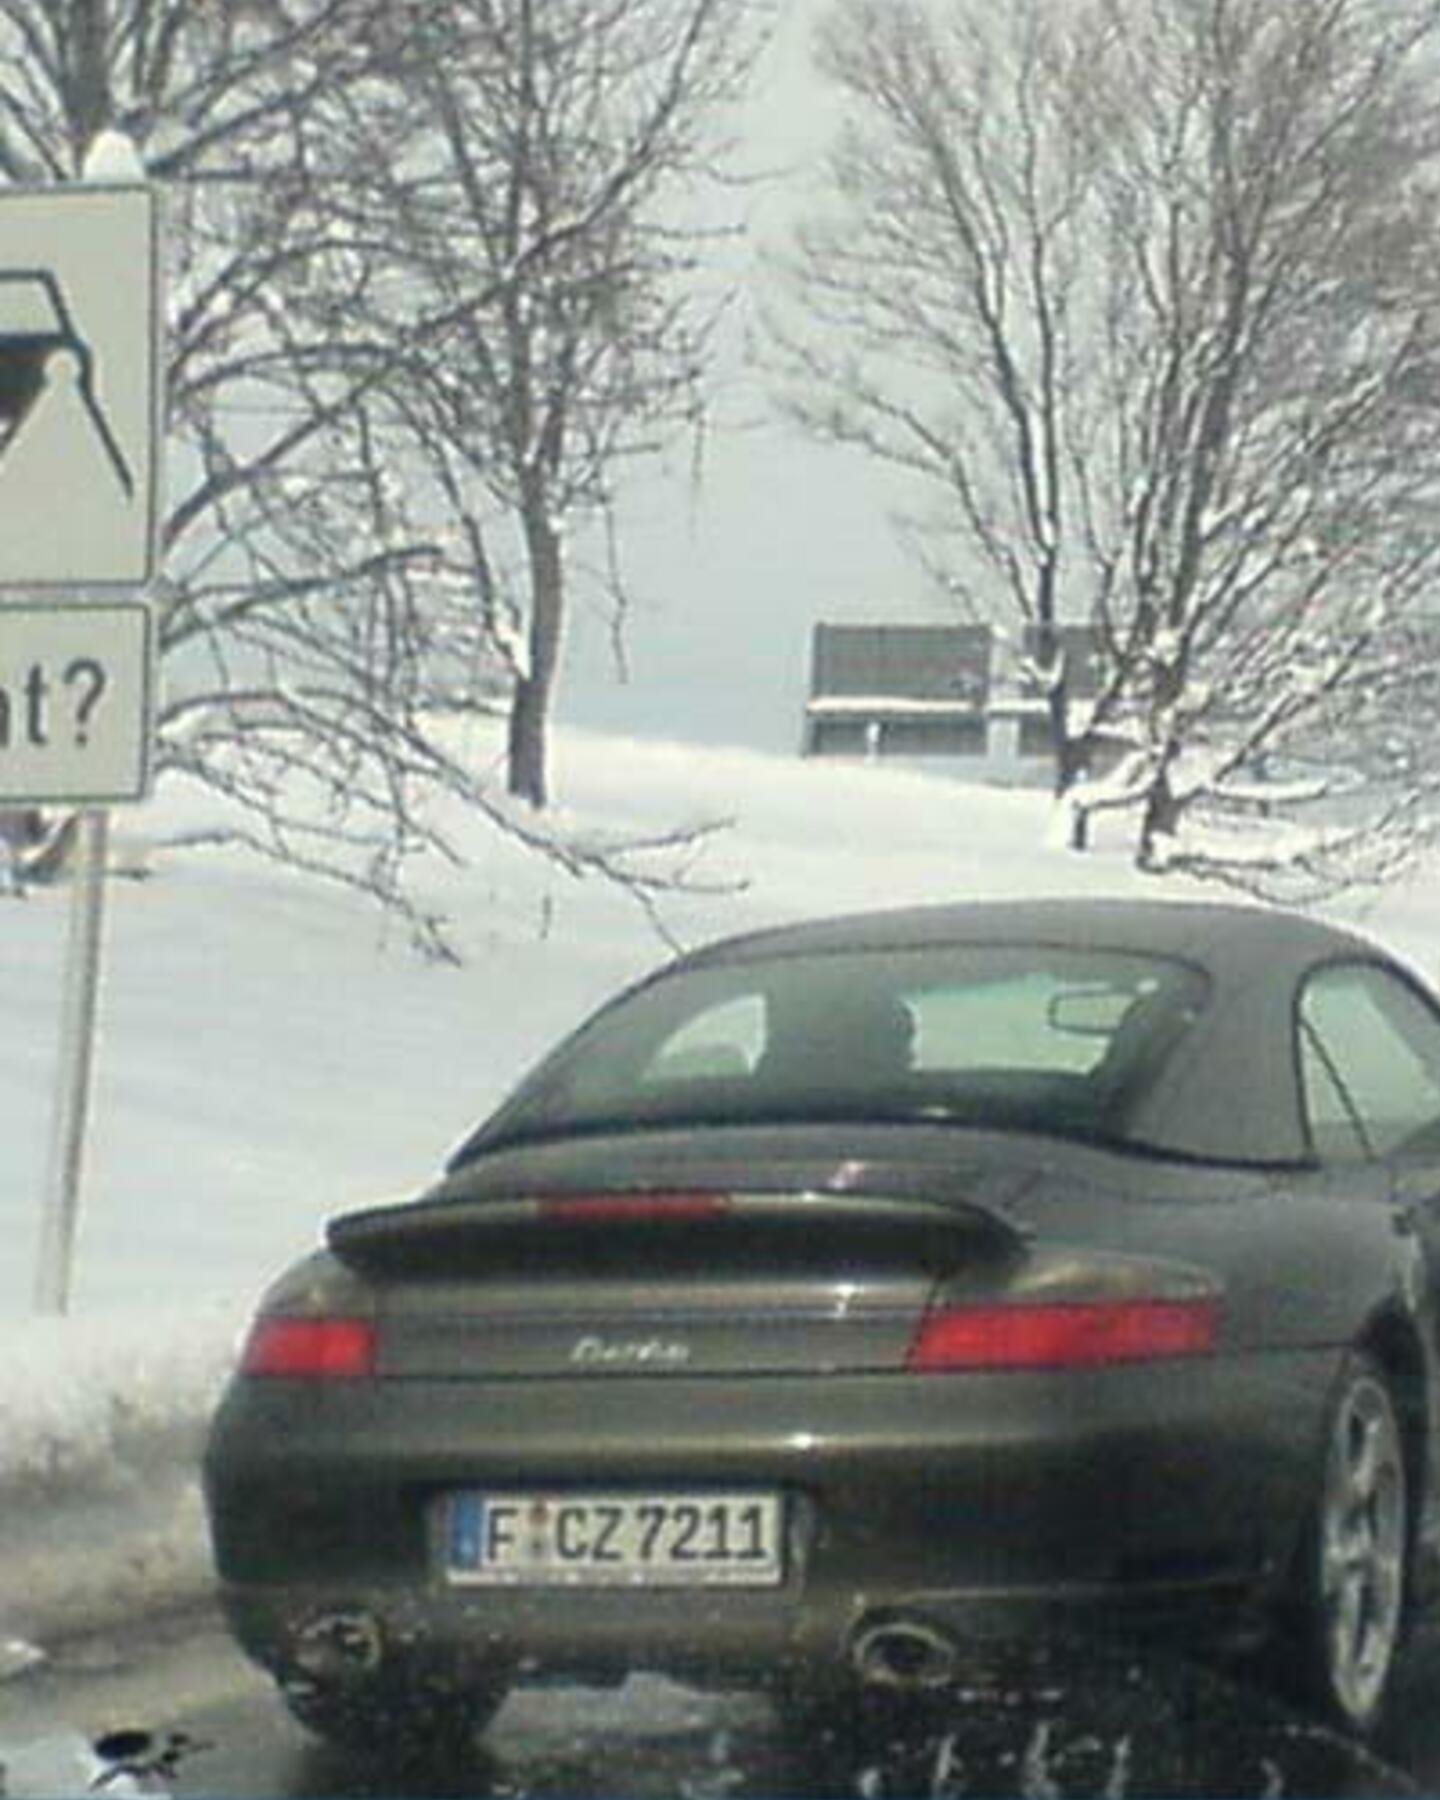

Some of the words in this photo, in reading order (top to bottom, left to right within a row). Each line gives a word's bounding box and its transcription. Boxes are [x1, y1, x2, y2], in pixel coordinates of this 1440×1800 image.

[0, 657, 106, 746] t?
[488, 1507, 518, 1560] F
[556, 1507, 622, 1561] CZ
[636, 1505, 767, 1561] 7211
